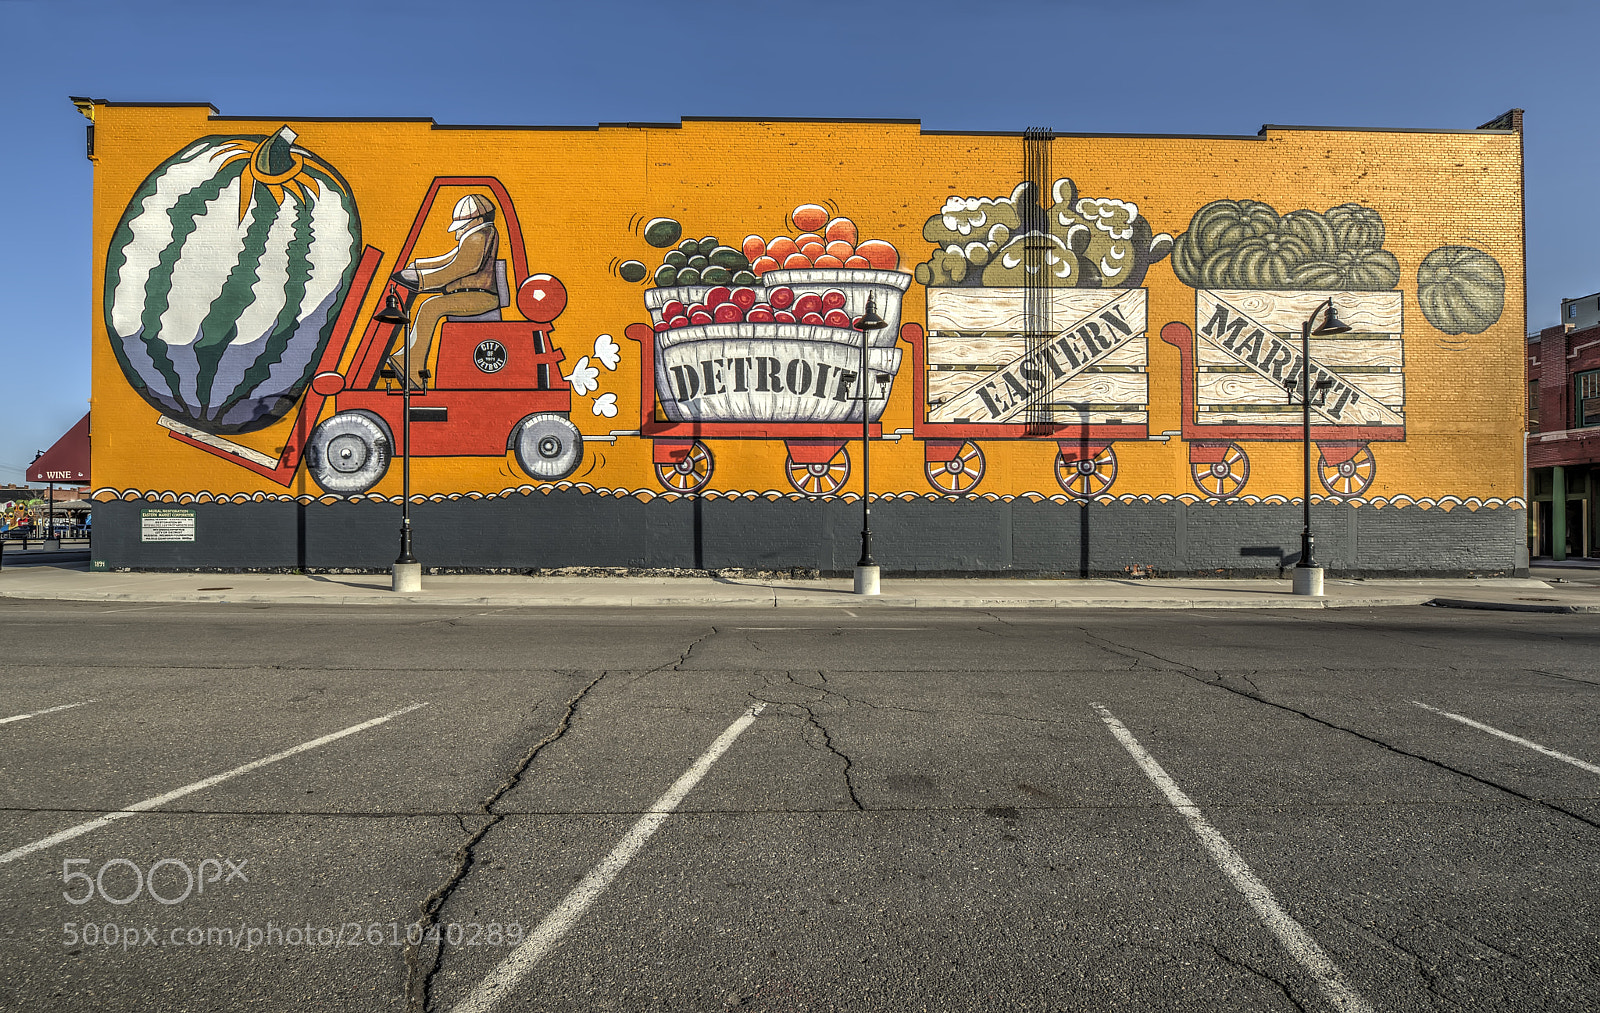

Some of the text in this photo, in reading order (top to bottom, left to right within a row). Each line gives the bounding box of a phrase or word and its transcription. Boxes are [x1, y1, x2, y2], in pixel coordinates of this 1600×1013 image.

[481, 343, 500, 351] CITY
[976, 304, 1133, 419] EASTERN
[1201, 303, 1360, 420] MARKET
[477, 357, 504, 370] DETROIT
[670, 356, 857, 403] DETROIT
[46, 471, 72, 479] WINE
